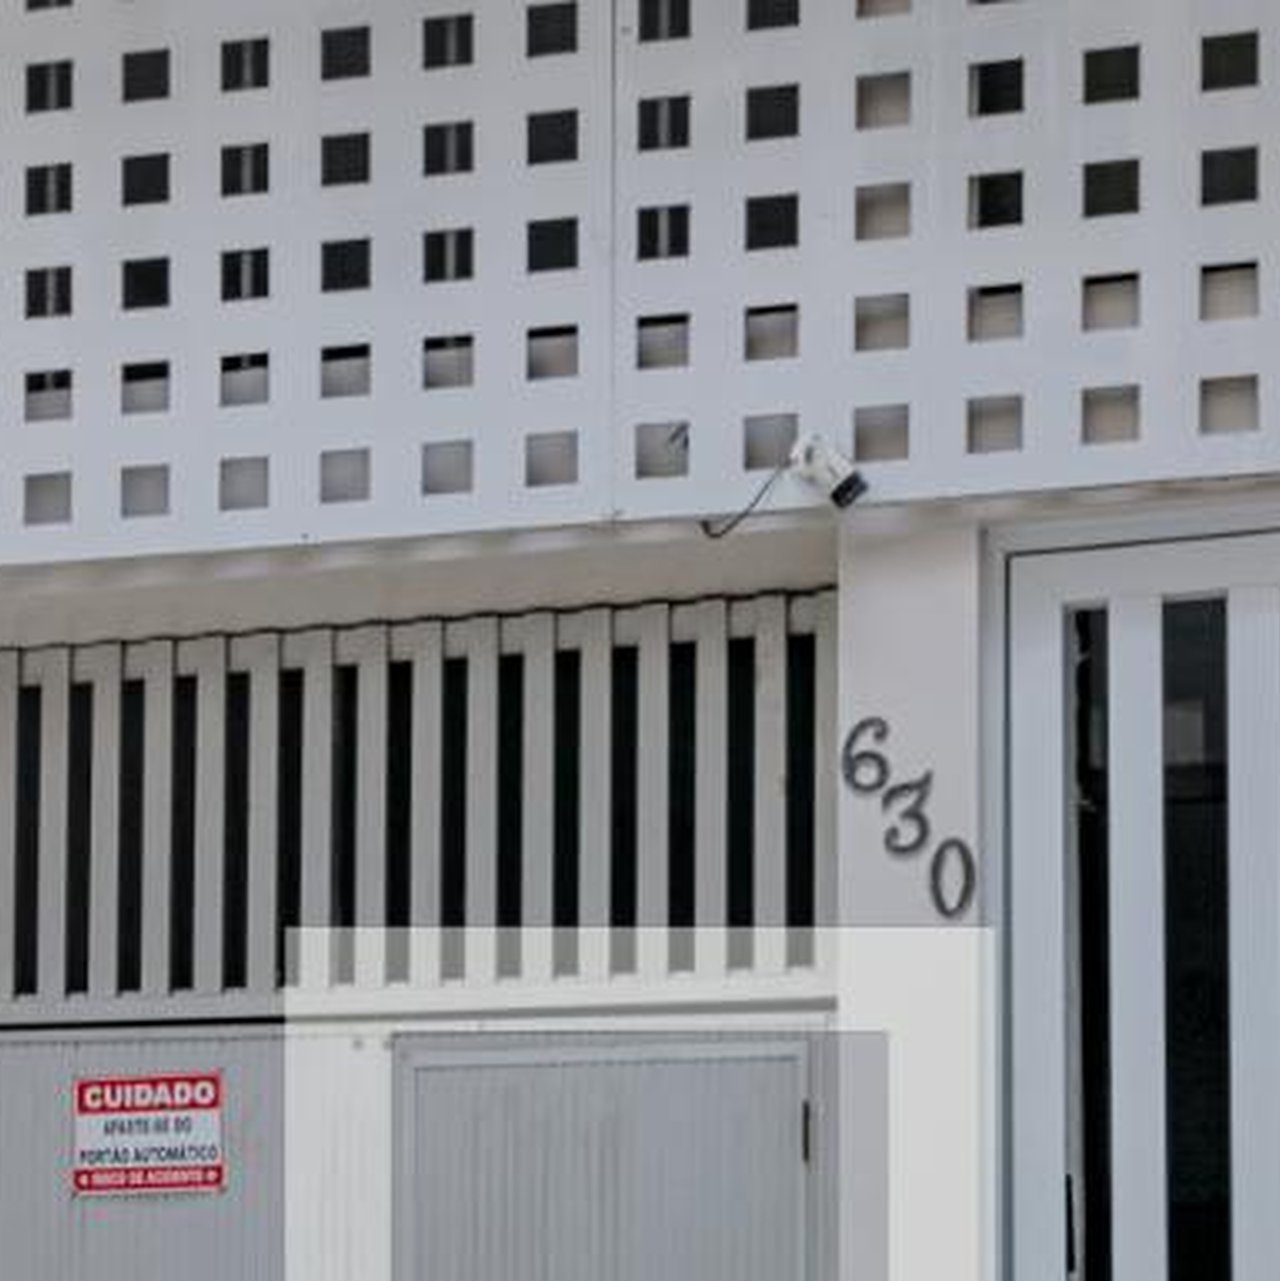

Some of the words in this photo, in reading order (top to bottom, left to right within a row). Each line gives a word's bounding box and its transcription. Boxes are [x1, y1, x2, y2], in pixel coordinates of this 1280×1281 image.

[841, 715, 976, 921] 630
[83, 1081, 216, 1109] CUIDADO
[173, 1114, 194, 1134] DO
[79, 1147, 129, 1167] PORTÃO
[132, 1142, 218, 1164] AUTOMÁTICO
